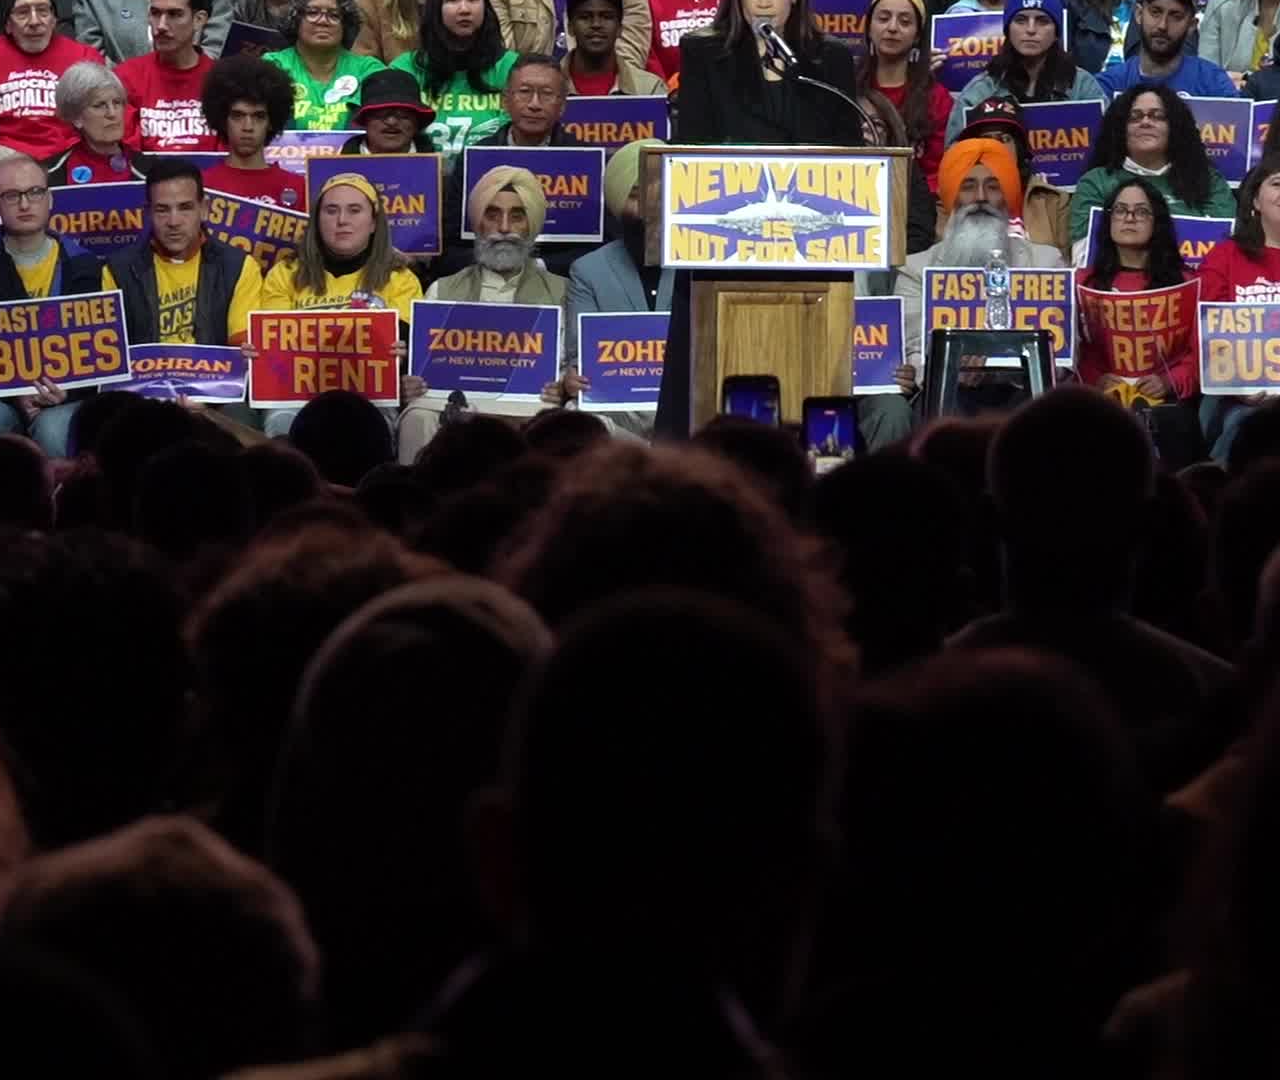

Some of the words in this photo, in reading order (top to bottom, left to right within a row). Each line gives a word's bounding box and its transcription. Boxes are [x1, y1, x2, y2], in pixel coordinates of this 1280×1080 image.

[948, 36, 1006, 57] ZOH
[140, 107, 203, 120] DEMOCRA
[425, 117, 472, 155] 37
[564, 121, 655, 143] OHRAN
[264, 145, 335, 159] ZOHR
[537, 174, 589, 197] RAN
[671, 161, 762, 212] NEW
[768, 161, 881, 215] YORK
[209, 198, 241, 228] ST
[381, 194, 425, 215] RAN
[48, 208, 144, 233] OHRAN
[763, 219, 793, 241] IS
[671, 223, 728, 262] NOT
[737, 239, 796, 263] FOR
[806, 225, 881, 264] SALE
[1011, 276, 1067, 302] FREE
[60, 297, 117, 329] FREE
[1084, 292, 1183, 332] FREEZE
[1207, 307, 1265, 334] FAST
[261, 317, 374, 355] FREEZE
[429, 328, 545, 355] ZOHRAN
[448, 356, 476, 366] NEW
[478, 356, 508, 367] YORK
[509, 358, 538, 369] CITY
[597, 339, 668, 363] ZOH
[858, 351, 884, 360] CITY
[132, 356, 233, 374] OHRAN
[294, 356, 389, 394] RENT
[619, 367, 647, 377] NEW
[648, 367, 664, 377] YO
